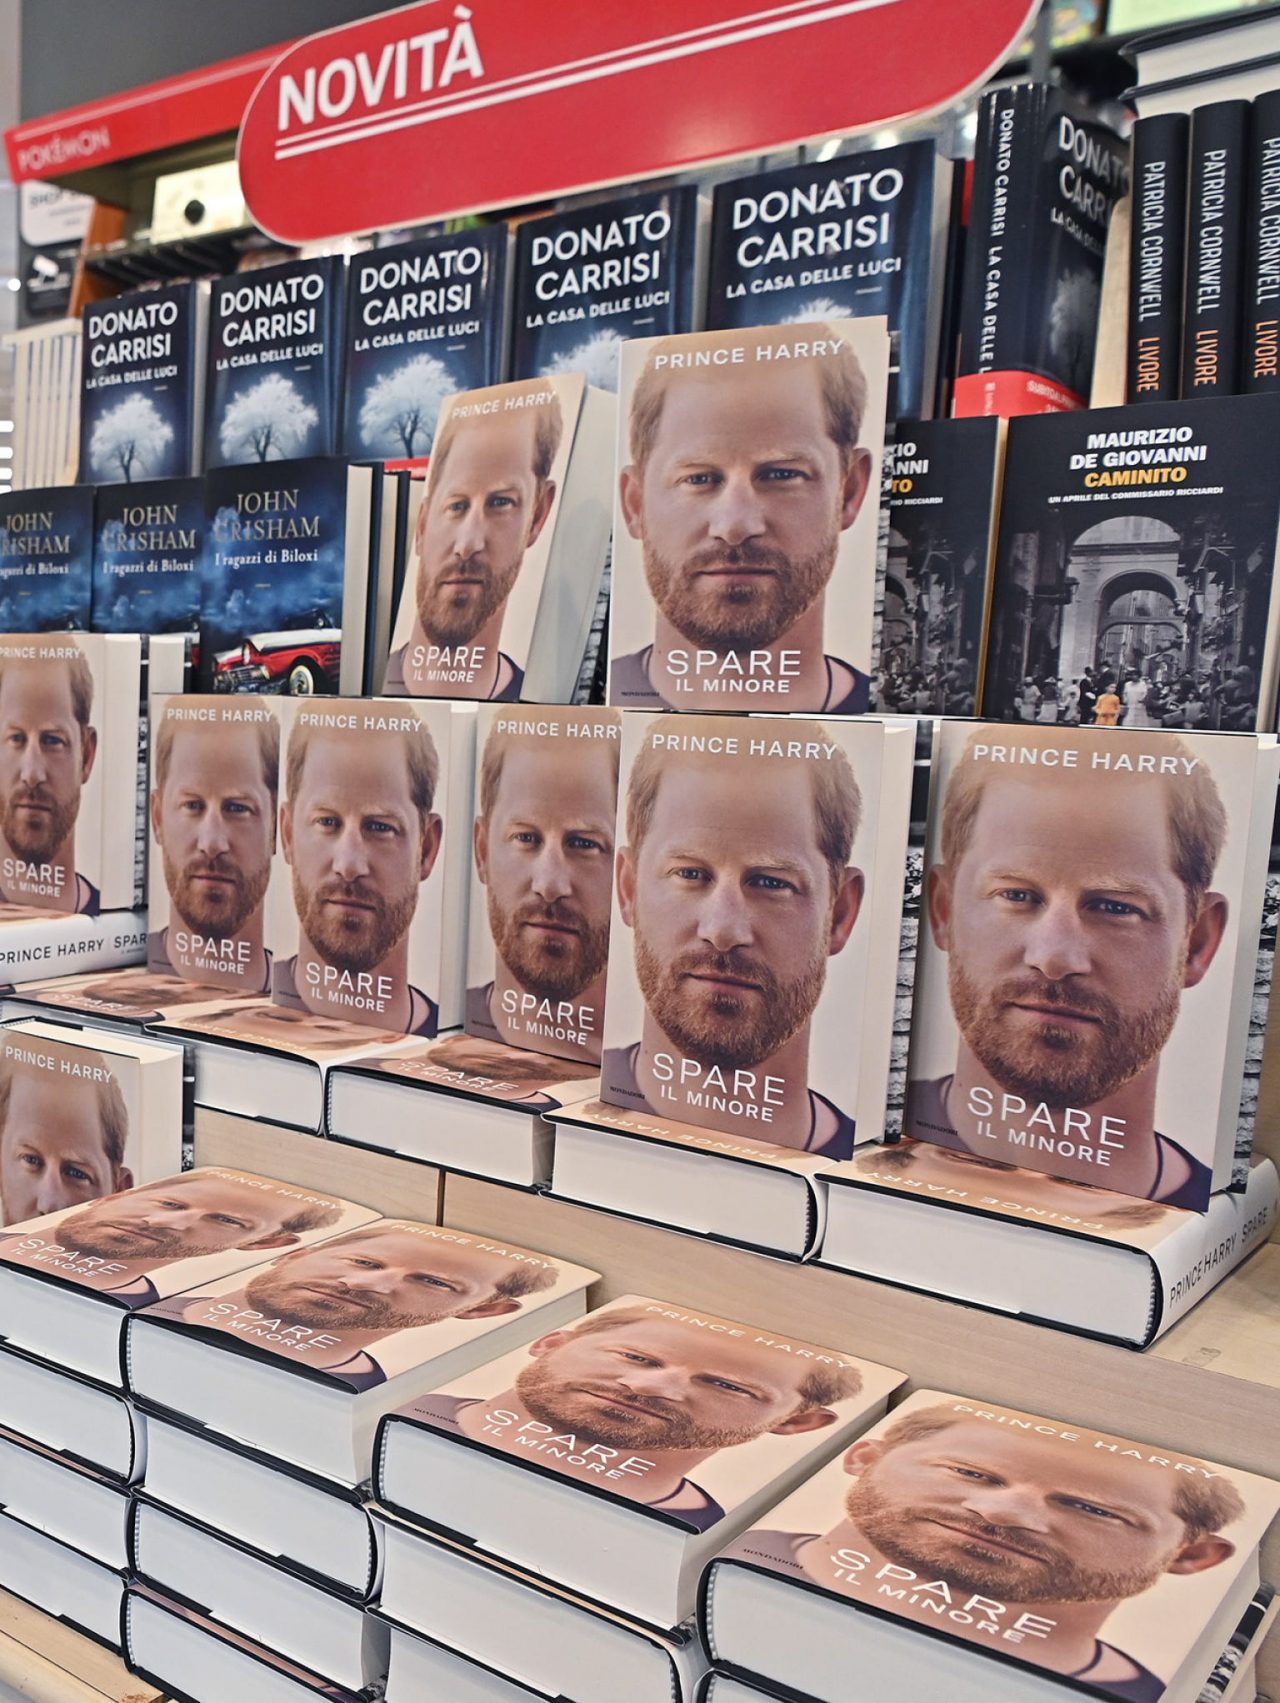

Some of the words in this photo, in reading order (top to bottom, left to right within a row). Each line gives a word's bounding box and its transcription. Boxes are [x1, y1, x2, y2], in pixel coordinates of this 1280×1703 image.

[277, 4, 486, 131] NOVITÀ
[17, 124, 111, 172] POKÉMON
[995, 108, 1015, 172] DONATO
[1200, 149, 1227, 223] PATRICIA
[1260, 137, 1280, 212] PATRICIA
[733, 168, 904, 230] DONATO
[990, 175, 1010, 237] CARRISI
[1141, 161, 1166, 233] PATRICIA
[531, 210, 671, 265] DONATO
[737, 212, 889, 269] CARRISI
[988, 245, 1004, 267] LA
[360, 247, 482, 294] DONATO
[535, 250, 660, 301] CARRISI
[726, 284, 746, 298] LA
[750, 275, 795, 294] CASA
[800, 265, 853, 286] DELLE
[858, 257, 902, 277] LUCI
[1196, 225, 1224, 315] CORNWELL
[1256, 214, 1280, 305] CORNWELL
[220, 274, 324, 317] DONATO
[984, 268, 1002, 311] CASA
[1138, 235, 1164, 322] CORNWELL
[89, 301, 179, 339] DONATO
[363, 283, 471, 326] CARRISI
[526, 314, 544, 328] LA
[547, 308, 586, 325] CASA
[589, 298, 632, 318] DELLE
[635, 291, 670, 307] LUCI
[222, 308, 316, 347] CARRISI
[355, 338, 369, 351] LA
[372, 333, 404, 349] CASA
[408, 328, 445, 343] DELLE
[448, 320, 480, 336] LUCI
[979, 314, 998, 368] DELLE
[91, 333, 172, 368] CARRISI
[216, 358, 228, 370] LA
[230, 353, 258, 368] CASA
[260, 348, 292, 363] DELLE
[295, 344, 324, 358] LUCI
[654, 347, 745, 370] PRINCE
[756, 340, 846, 362] HARRY
[1136, 336, 1161, 393] LIVORE
[1193, 329, 1218, 387] LIVORE
[1253, 319, 1280, 378] LIVORE
[98, 374, 122, 387] CASA
[124, 369, 152, 383] DELLE
[154, 365, 178, 380] LUCI
[451, 399, 500, 420] PRINCE
[504, 390, 557, 411] HARRY
[1087, 426, 1193, 450] MAURIZIO
[1070, 453, 1098, 470] DE
[1102, 445, 1207, 468] GIOVANNI
[1047, 496, 1061, 504] UN
[1062, 494, 1092, 503] APRILE
[1093, 493, 1110, 501] DEL
[1111, 489, 1175, 500] COMMISSARIO
[1176, 487, 1224, 496] RICCIARDI
[1084, 466, 1188, 488] CAMINITO
[122, 504, 177, 527] JOHN
[236, 489, 299, 515] JOHN
[6, 512, 54, 532] JOHN
[213, 515, 320, 543] GRISHAM
[102, 529, 196, 553] GRISHAM
[223, 552, 261, 570] ragazzi
[264, 550, 277, 564] di
[281, 548, 319, 563] Biloxi
[161, 558, 194, 572] Biloxi
[39, 647, 81, 660] HARRY
[412, 645, 486, 670] SPARE
[666, 649, 802, 676] SPARE
[413, 669, 424, 681] IL
[427, 670, 474, 683] MINORE
[676, 679, 693, 691] IL
[703, 679, 790, 694] MINORE
[166, 708, 216, 721] PRINCE
[222, 709, 273, 723] HARRY
[300, 714, 357, 728] PRINCE
[364, 717, 422, 732] HARRY
[497, 720, 559, 736] PRINCE
[651, 734, 738, 755] PRINCE
[749, 739, 838, 761] HARRY
[973, 744, 1079, 768] PRINCE
[1091, 752, 1200, 776] HARRY
[3, 858, 65, 885] SPARE
[7, 881, 16, 890] IL
[19, 882, 61, 898] MINORE
[57, 938, 104, 957] HARRY
[114, 932, 147, 949] SPAR
[175, 932, 251, 962] SPARE
[180, 953, 192, 966] IL
[195, 956, 245, 975] MINORE
[305, 962, 393, 999] SPARE
[311, 986, 323, 1000] IL
[328, 989, 385, 1012] MINORE
[501, 989, 595, 1031] SPARE
[507, 1016, 521, 1031] IL
[526, 1020, 587, 1046] MINORE
[5, 1046, 56, 1071] PRINCE
[60, 1060, 113, 1083] HARRY
[401, 1061, 519, 1091] SPARE
[421, 1071, 498, 1092] MINORE
[651, 1052, 785, 1106] SPARE
[660, 1084, 678, 1100] IL
[686, 1089, 774, 1123] MINORE
[967, 1086, 1128, 1149] SPARE
[977, 1121, 997, 1139] IL
[1008, 1128, 1112, 1167] MINORE
[206, 1170, 273, 1191] PRINCE
[277, 1188, 339, 1210] HARRY
[864, 1172, 967, 1198] HARRY
[982, 1196, 1105, 1231] PRINCE
[19, 1238, 128, 1275] SPARE
[391, 1223, 471, 1246] PRINCE
[476, 1242, 552, 1270] HARRY
[1169, 1259, 1203, 1308] PRINCE
[1203, 1232, 1238, 1273] HARRY
[1241, 1207, 1269, 1244] SPARE
[29, 1254, 100, 1278] MINORE
[202, 1314, 218, 1322] IL
[226, 1320, 311, 1352] MINORE
[208, 1303, 342, 1349] SPARE
[644, 1306, 745, 1338] PRINCE
[755, 1335, 854, 1369] HARRY
[481, 1424, 504, 1438] IL
[513, 1435, 626, 1481] MINORE
[483, 1409, 657, 1478] SPARE
[953, 1404, 1082, 1442] PRINCE
[1093, 1440, 1221, 1480] HARRY
[829, 1547, 1058, 1640] SPARE
[833, 1570, 859, 1584] IL
[878, 1583, 1027, 1645] MINORE
